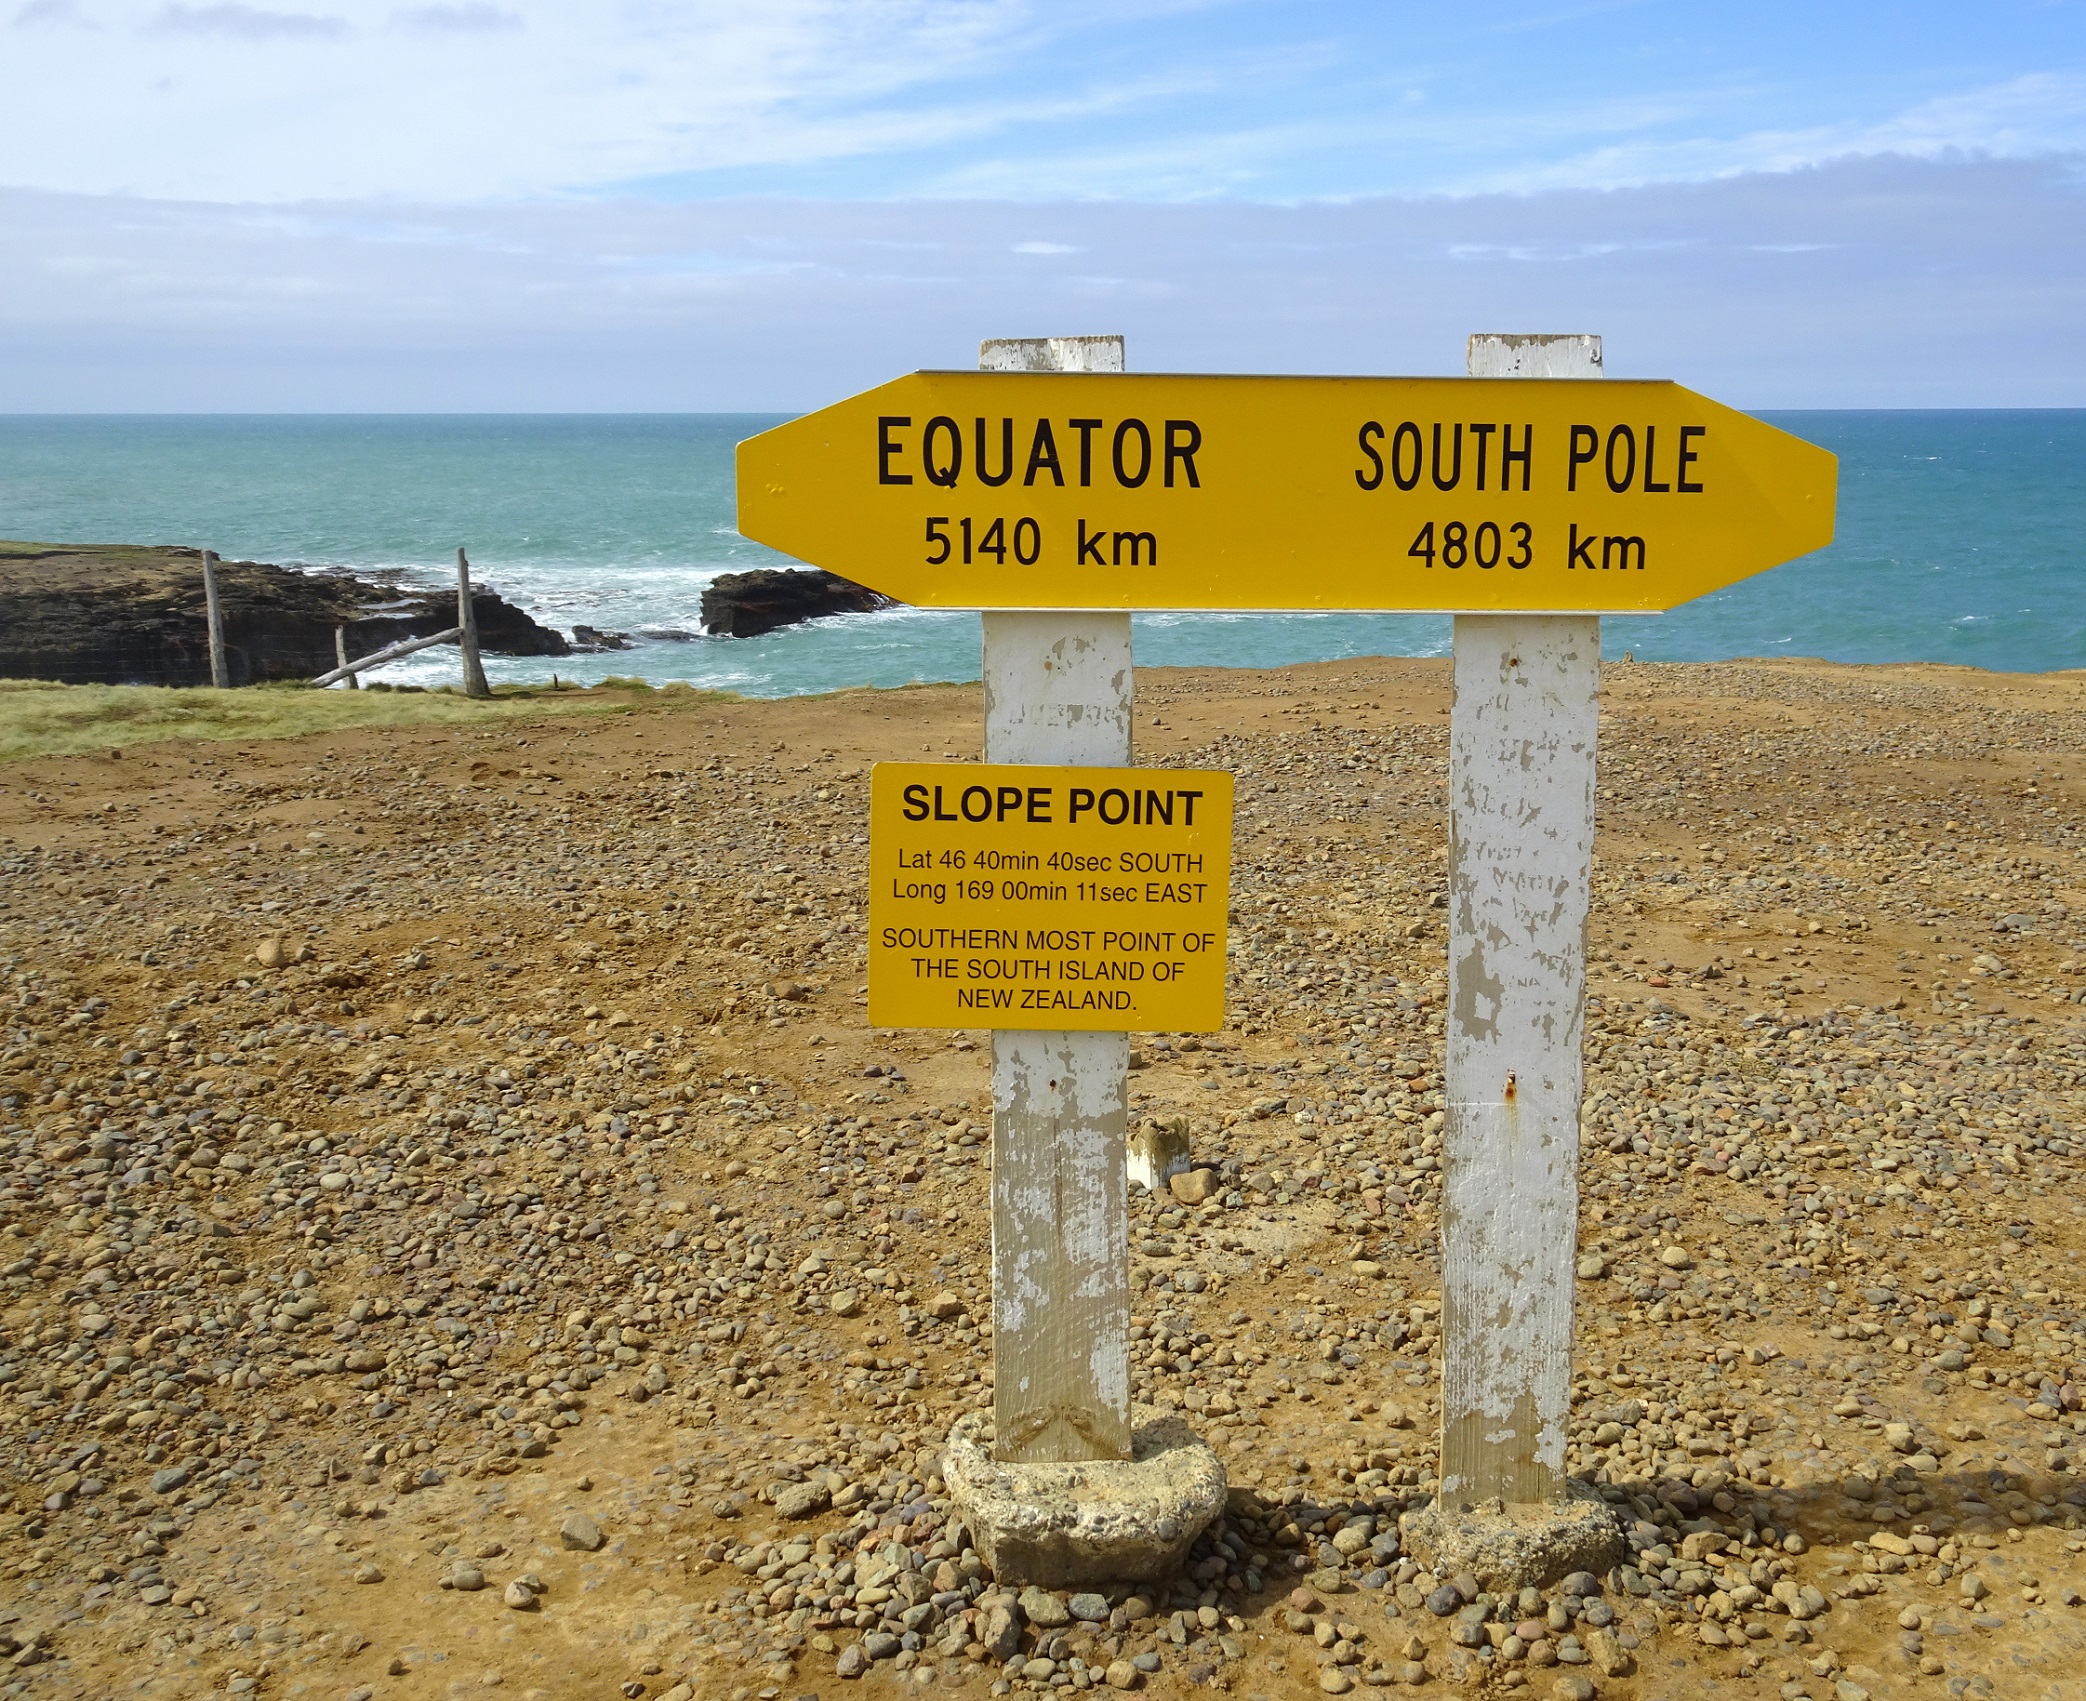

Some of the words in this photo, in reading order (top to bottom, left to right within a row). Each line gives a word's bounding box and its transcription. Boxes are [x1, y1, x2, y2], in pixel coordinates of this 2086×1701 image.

[878, 416, 1201, 489] EQUATOR
[1355, 421, 1532, 491] SOUTH
[1568, 424, 1705, 493] POLE
[926, 517, 1040, 565] 5140
[1078, 519, 1157, 566] km
[1408, 521, 1533, 569] 4803
[1568, 524, 1646, 569] km
[903, 785, 1052, 823] SLOPE
[1069, 789, 1204, 826] POINT
[899, 849, 932, 869] Lat
[939, 850, 966, 870] 46
[973, 850, 1039, 871] 40min
[1046, 851, 1112, 872] 40sec
[1119, 852, 1203, 873] SOUTH
[893, 879, 946, 904] Long
[955, 880, 994, 900] 169
[1001, 880, 1067, 901] 00min
[1076, 882, 1138, 902] 11sec
[1145, 883, 1208, 903] EAST
[882, 928, 1018, 950] SOUTHERN
[1026, 930, 1096, 951] MOST
[1103, 932, 1176, 952] POINT
[1182, 933, 1216, 952] OF
[911, 959, 959, 978] THE
[967, 959, 1050, 980] SOUTH
[1059, 961, 1145, 981] ISLAND
[1152, 962, 1186, 981] OF
[958, 989, 1013, 1008] NEW
[1021, 990, 1137, 1010] ZEALAND.
